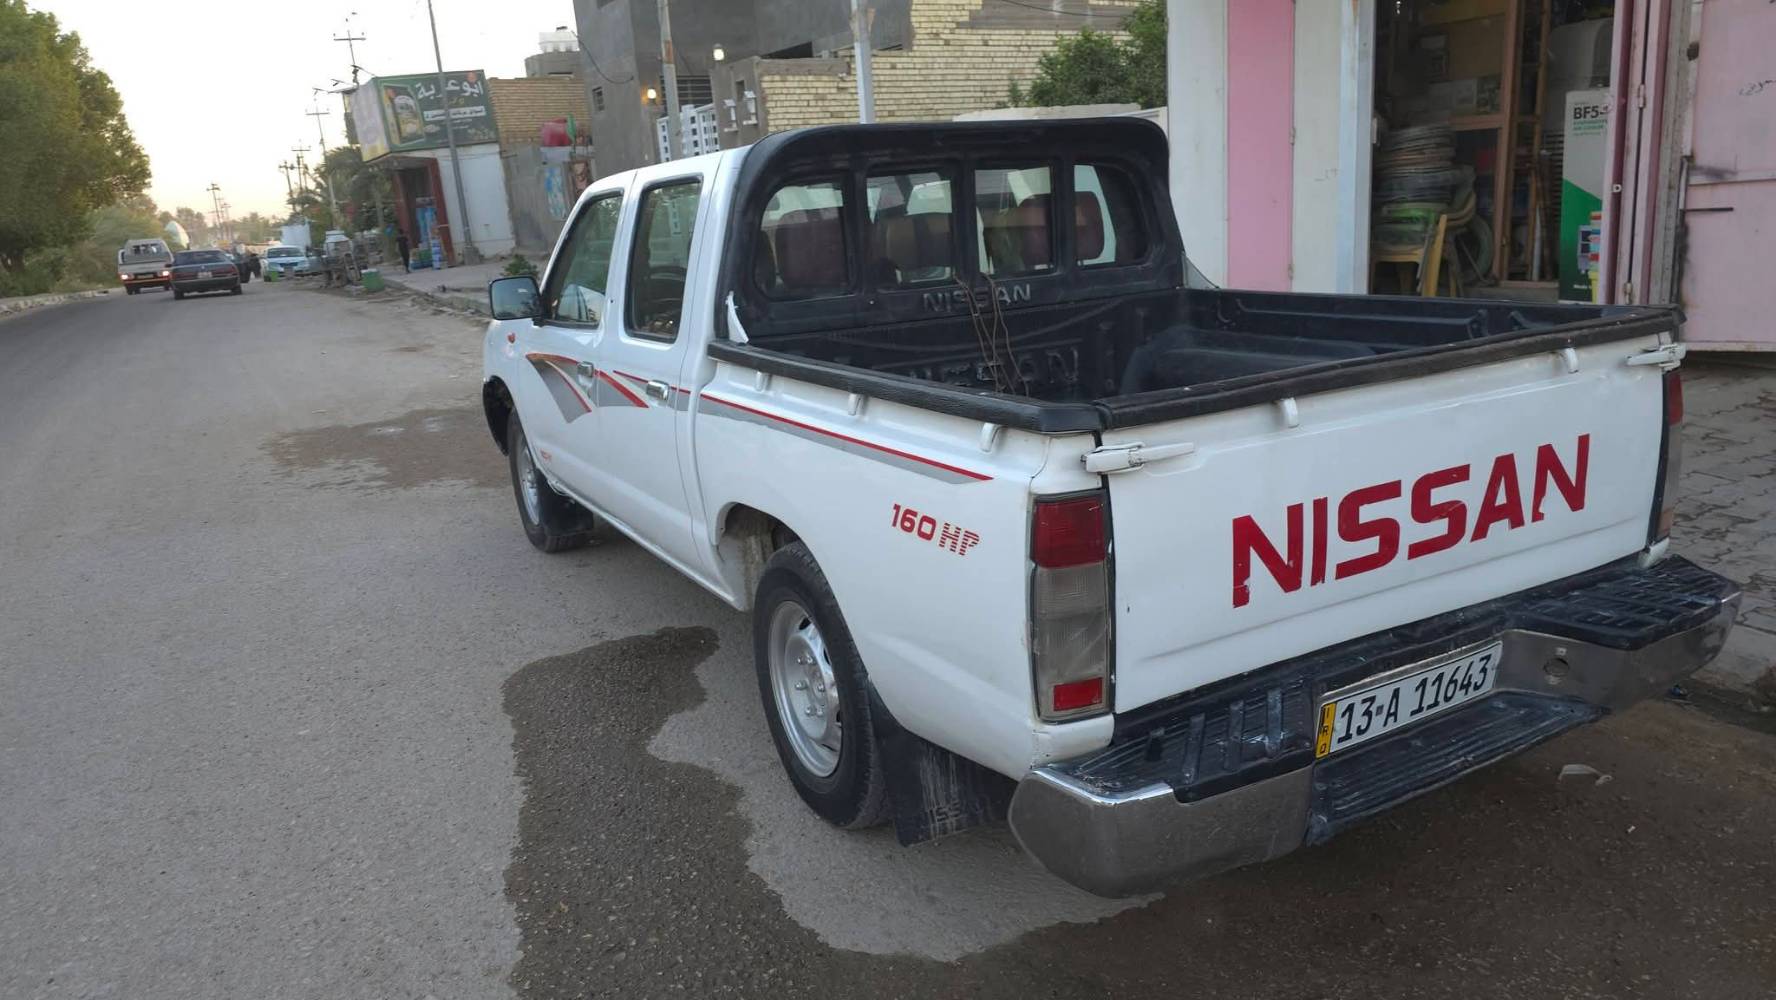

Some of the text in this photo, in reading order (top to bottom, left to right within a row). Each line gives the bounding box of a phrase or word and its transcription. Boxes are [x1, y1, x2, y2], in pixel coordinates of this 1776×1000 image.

[891, 503, 980, 556] 160 HP
[1232, 433, 1590, 608] NISSAN
[1410, 654, 1492, 717] 11643
